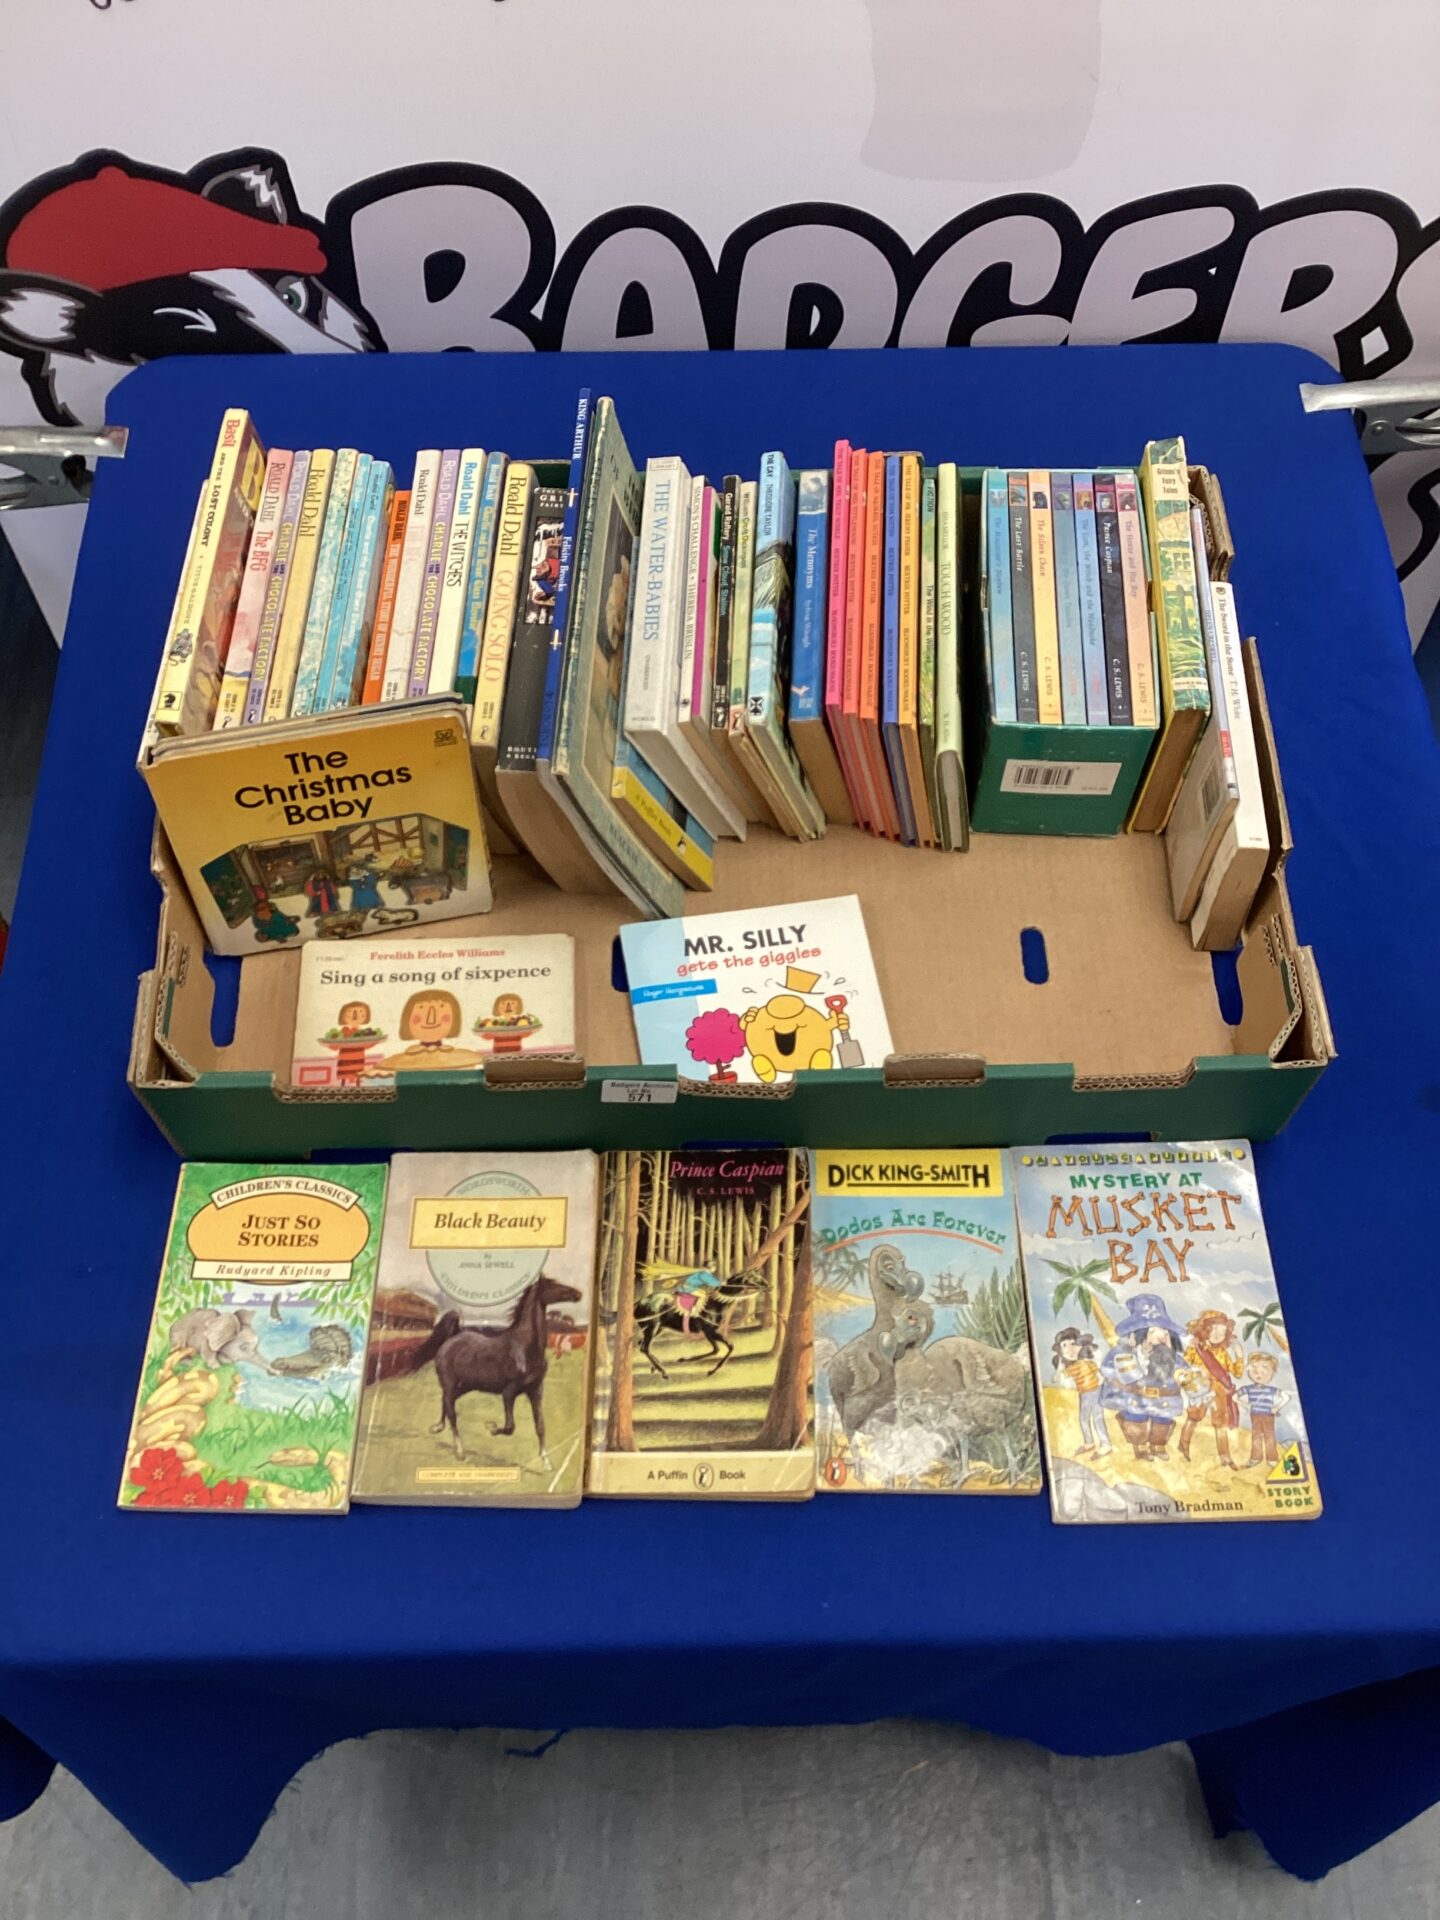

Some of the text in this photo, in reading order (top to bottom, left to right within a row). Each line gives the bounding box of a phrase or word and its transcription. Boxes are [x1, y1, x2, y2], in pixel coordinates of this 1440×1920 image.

[325, 161, 1440, 380] BADGER
[221, 419, 240, 447] Basil
[571, 398, 586, 458] KING ARTHUR
[416, 469, 430, 492] Roald
[439, 460, 456, 490] ROALD
[208, 484, 221, 510] LOST
[298, 468, 325, 536] Roald Dahl
[413, 494, 426, 514] Dahl
[434, 492, 451, 517] DAHL
[503, 476, 526, 515] Roald
[652, 480, 670, 514] THE
[723, 492, 733, 514] Gerald
[741, 493, 750, 515] William
[762, 454, 775, 535] THE CAY THEODORE TAYLOR
[200, 511, 215, 546] COLONY
[250, 462, 285, 571] ROALD DAHL The BFG
[446, 462, 477, 587] Roald Dahl THE WITCHES
[721, 516, 732, 539] Raftery
[1013, 517, 1022, 529] The
[1036, 519, 1045, 530] The
[274, 522, 294, 562] CHARLIE
[429, 521, 445, 562] CHARLIE
[498, 520, 521, 555] Dahl
[807, 529, 817, 542] The
[1102, 522, 1112, 543] Prince
[688, 522, 699, 573] CHALLENGE
[721, 545, 730, 563] Snow
[555, 536, 572, 591] Felicity Brooks
[803, 545, 817, 588] Mennyms
[642, 517, 668, 640] WATER-BABIES
[925, 585, 933, 596] The
[261, 575, 284, 633] CHOCOLATE
[419, 575, 438, 634] CHOCOLATE
[489, 570, 516, 629] GOING
[685, 583, 696, 621] THERESA
[718, 589, 728, 615] Stallion
[925, 599, 933, 614] Wind
[942, 561, 951, 634] TOUCH WOOD
[1218, 598, 1228, 612] The
[925, 624, 933, 635] the
[1219, 613, 1231, 634] Sword
[683, 623, 693, 659] BRESLIN
[1223, 643, 1233, 654] the
[251, 636, 272, 682] FACTORY
[412, 634, 430, 682] FACTORY
[483, 631, 509, 682] SOLO
[1224, 657, 1236, 675] Stone
[1020, 670, 1029, 690] LEWIS
[1044, 676, 1053, 695] LEWIS
[1113, 677, 1123, 697] LEWIS
[1231, 698, 1242, 718] White
[285, 750, 349, 775] The
[234, 765, 412, 809] Christmas
[283, 796, 373, 826] Baby
[684, 924, 807, 957] MR. SILLY
[370, 948, 506, 961] Ferelith Eccles Williams
[677, 946, 822, 977] gets the giggles
[320, 966, 552, 987] Sing a song of sixpence
[628, 1093, 652, 1102] 571
[669, 1160, 785, 1183] Prince Caspian
[828, 1163, 990, 1188] DICK KING-SMITH
[1069, 1172, 1204, 1190] MYSTERY AT
[216, 1180, 353, 1204] CHILDREN'S CLASSICS
[697, 1186, 755, 1196] C. S. LEWIS
[242, 1214, 289, 1230] JUST
[434, 1212, 546, 1232] Black Beauty
[1045, 1190, 1242, 1238] MUSKET
[237, 1231, 320, 1247] STORIES
[822, 1208, 1006, 1246] Dodos Are Forever
[216, 1264, 332, 1277] Rudyard Kipling
[1107, 1237, 1194, 1284] BAY
[647, 1469, 746, 1481] A Puffin Book
[1266, 1485, 1310, 1497] STORY
[1274, 1496, 1314, 1508] BOOK
[1134, 1499, 1243, 1515] Tony Bradman
